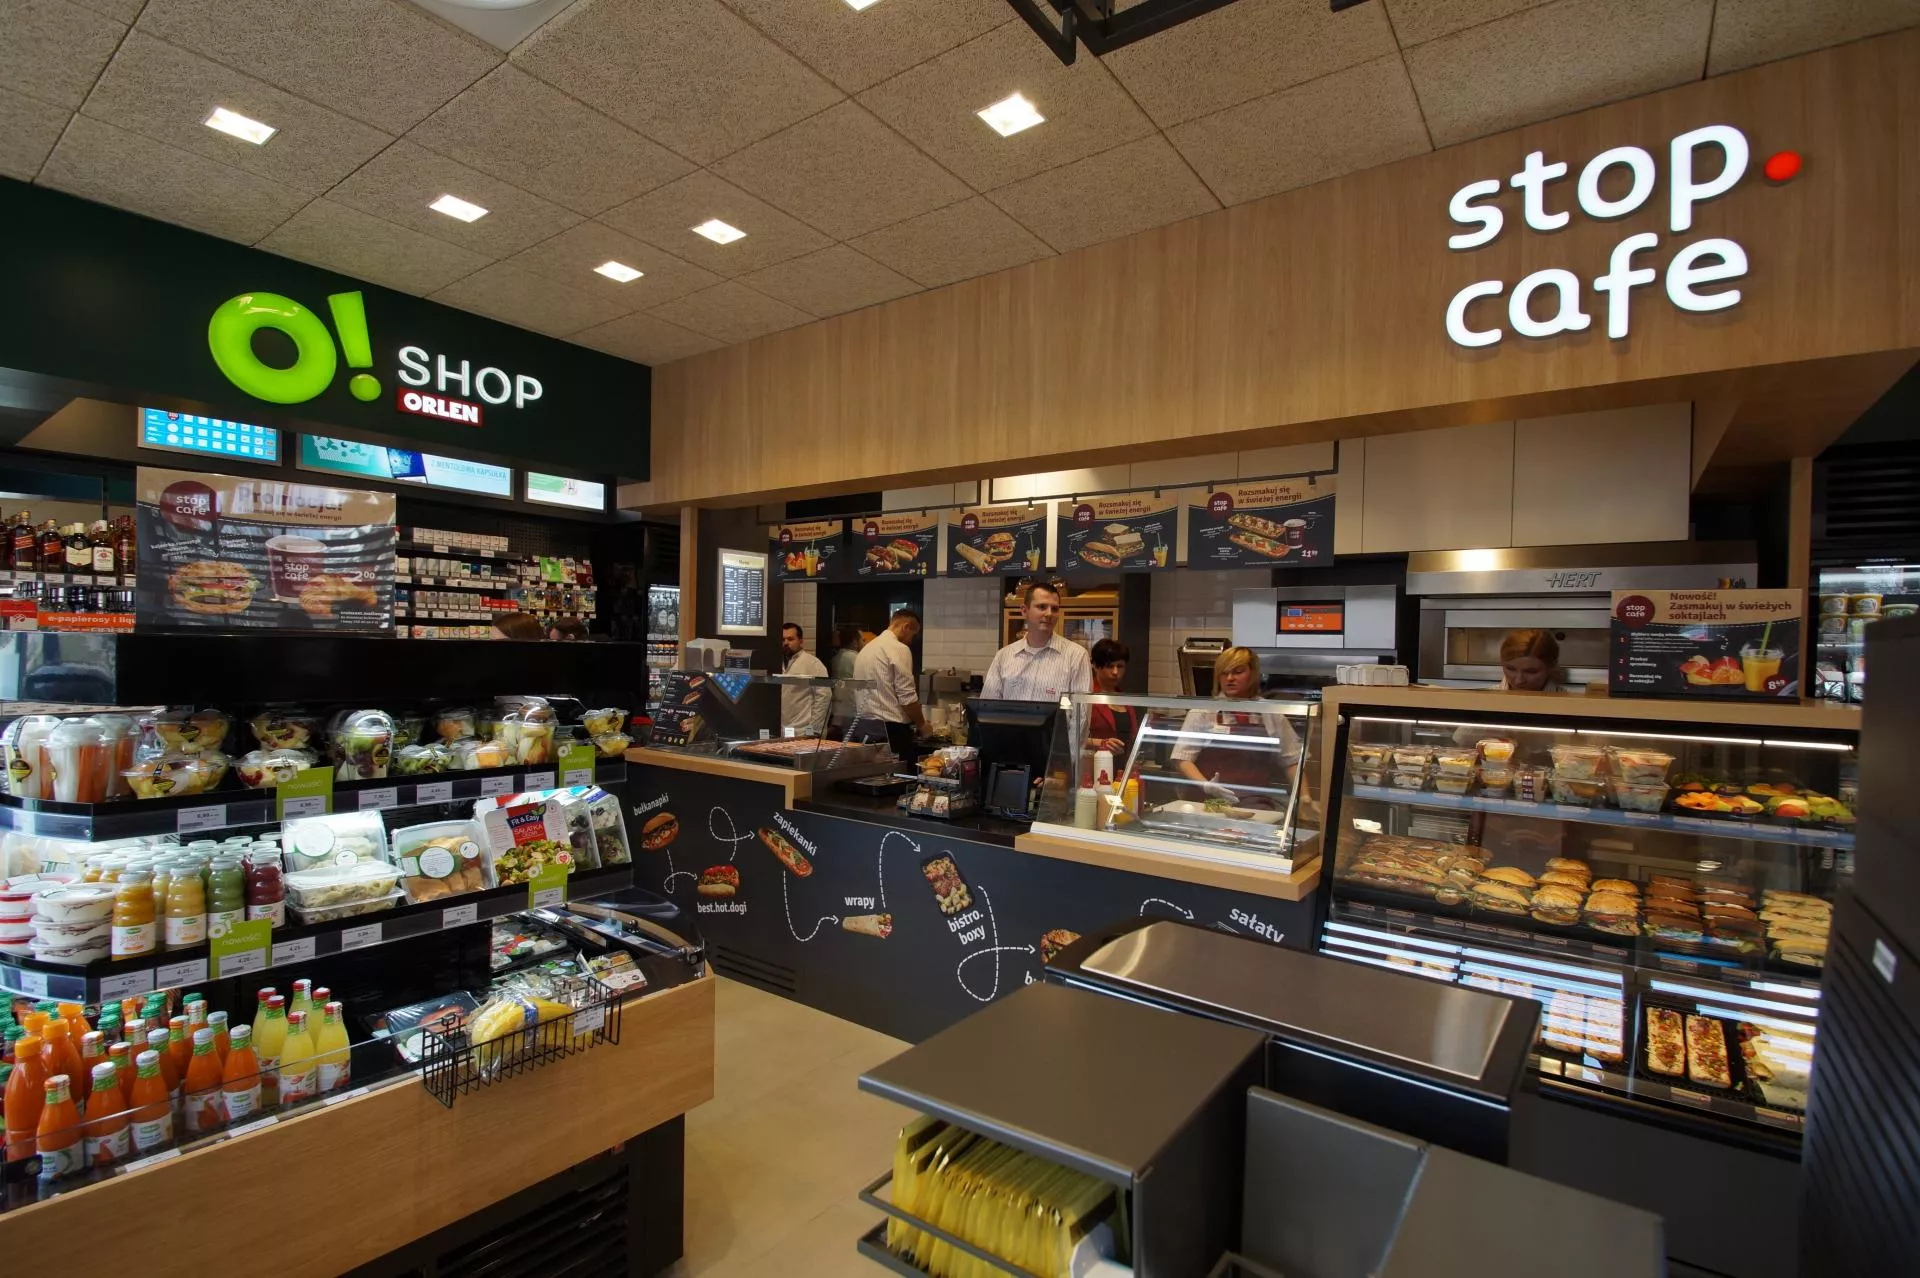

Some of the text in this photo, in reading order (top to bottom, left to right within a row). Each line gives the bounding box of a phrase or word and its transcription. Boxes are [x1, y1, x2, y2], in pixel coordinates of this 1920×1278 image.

[1446, 232, 1749, 348] cafe
[208, 290, 382, 404] O!
[397, 346, 544, 409] SHOP
[404, 392, 479, 424] ORLEN
[1238, 486, 1290, 496] Rozsmakuj się
[176, 494, 206, 508] stop
[1099, 500, 1131, 509] Rozsmakuj
[1245, 496, 1274, 504] świeżej
[1276, 493, 1302, 502] energii
[176, 504, 206, 516] cafe
[284, 563, 309, 574] stop
[284, 571, 309, 580] cafe
[1547, 572, 1602, 588] HERT
[1670, 592, 1717, 601] Nowość!
[1626, 604, 1646, 612] stop
[1669, 602, 1722, 613] Zasmakuj
[1739, 600, 1792, 613] świeżych
[48, 615, 109, 624] e-papierosy
[1669, 612, 1726, 621] soktajlach
[632, 792, 670, 817] bułkanapki
[514, 824, 543, 834] SAŁATKA
[772, 811, 817, 857] zapiekanki
[697, 901, 747, 915] best.hot.dogi
[844, 894, 875, 909] wrapy
[947, 909, 984, 934] bistro.
[958, 924, 986, 946] boxy
